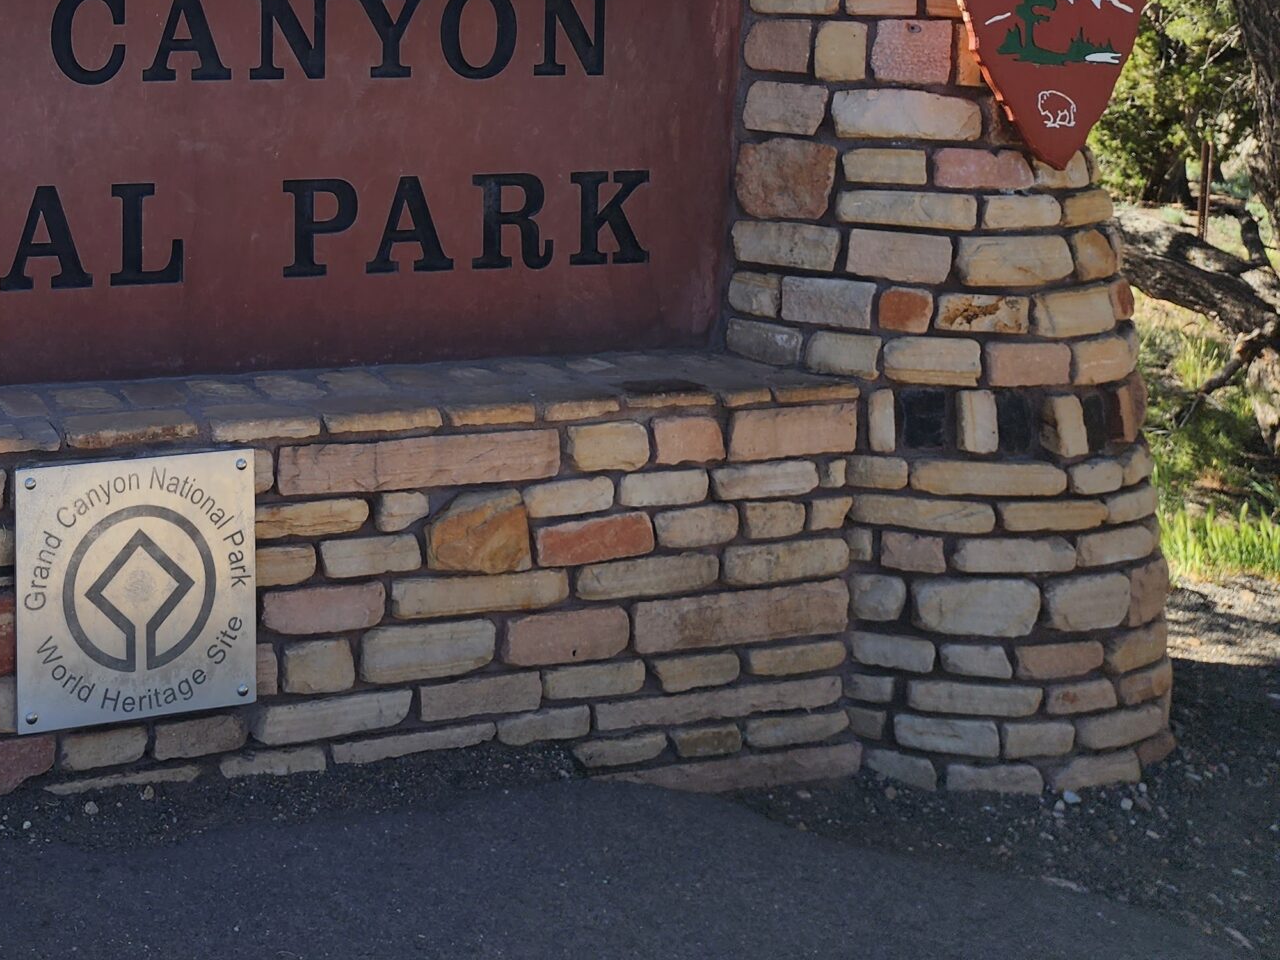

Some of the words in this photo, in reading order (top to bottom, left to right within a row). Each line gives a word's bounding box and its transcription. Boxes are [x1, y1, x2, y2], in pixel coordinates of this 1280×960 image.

[282, 170, 651, 278] PARK
[24, 531, 62, 611] Grand
[56, 472, 140, 529] Canyon
[149, 466, 234, 530] National
[223, 530, 252, 588] Park
[36, 636, 96, 703] World
[101, 668, 206, 713] Heritage
[207, 616, 243, 665] Site
